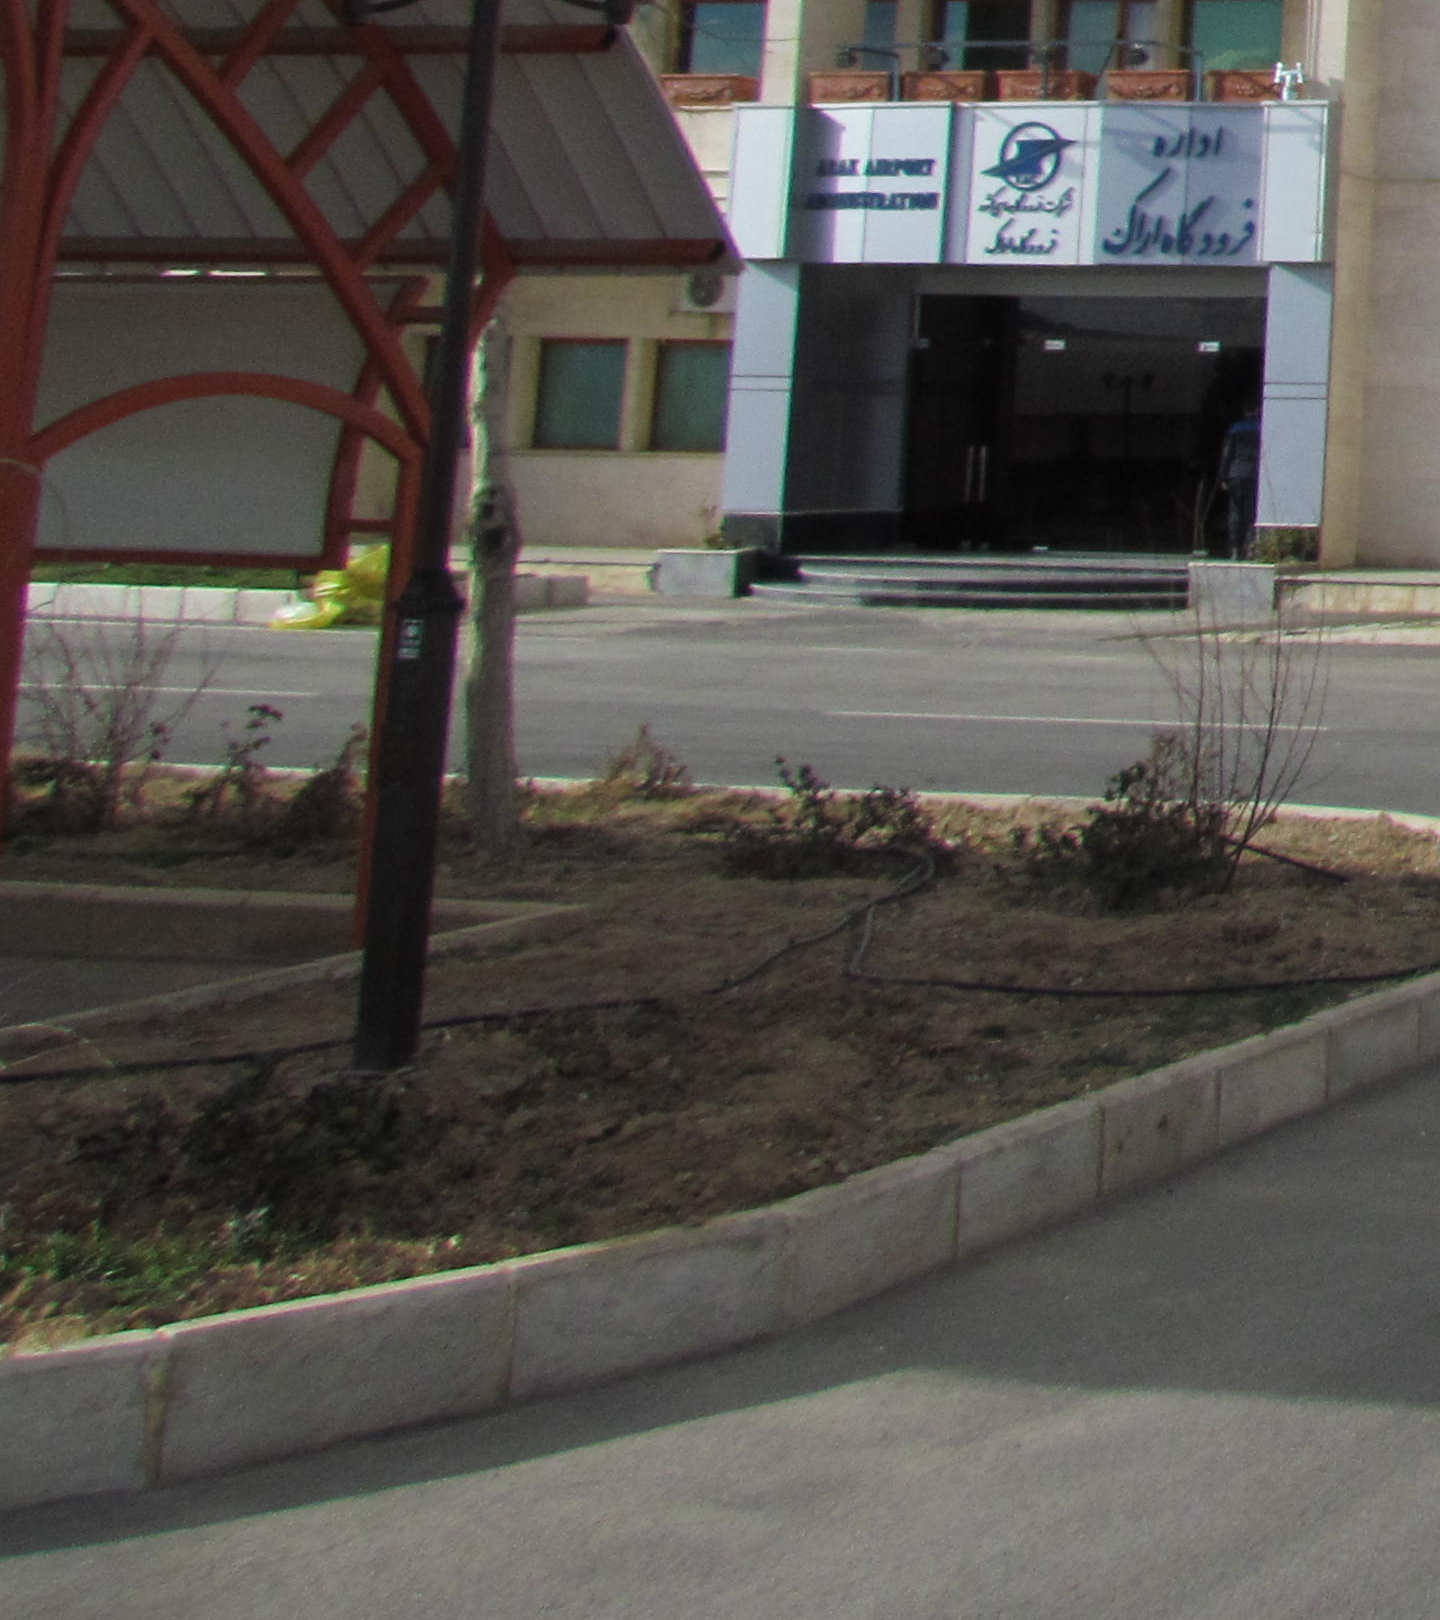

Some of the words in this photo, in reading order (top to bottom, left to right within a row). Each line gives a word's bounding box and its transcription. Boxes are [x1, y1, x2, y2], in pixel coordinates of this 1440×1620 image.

[1151, 124, 1224, 158] اداره
[1101, 166, 1172, 255] اراک
[1159, 195, 1256, 256] فرودگاه
